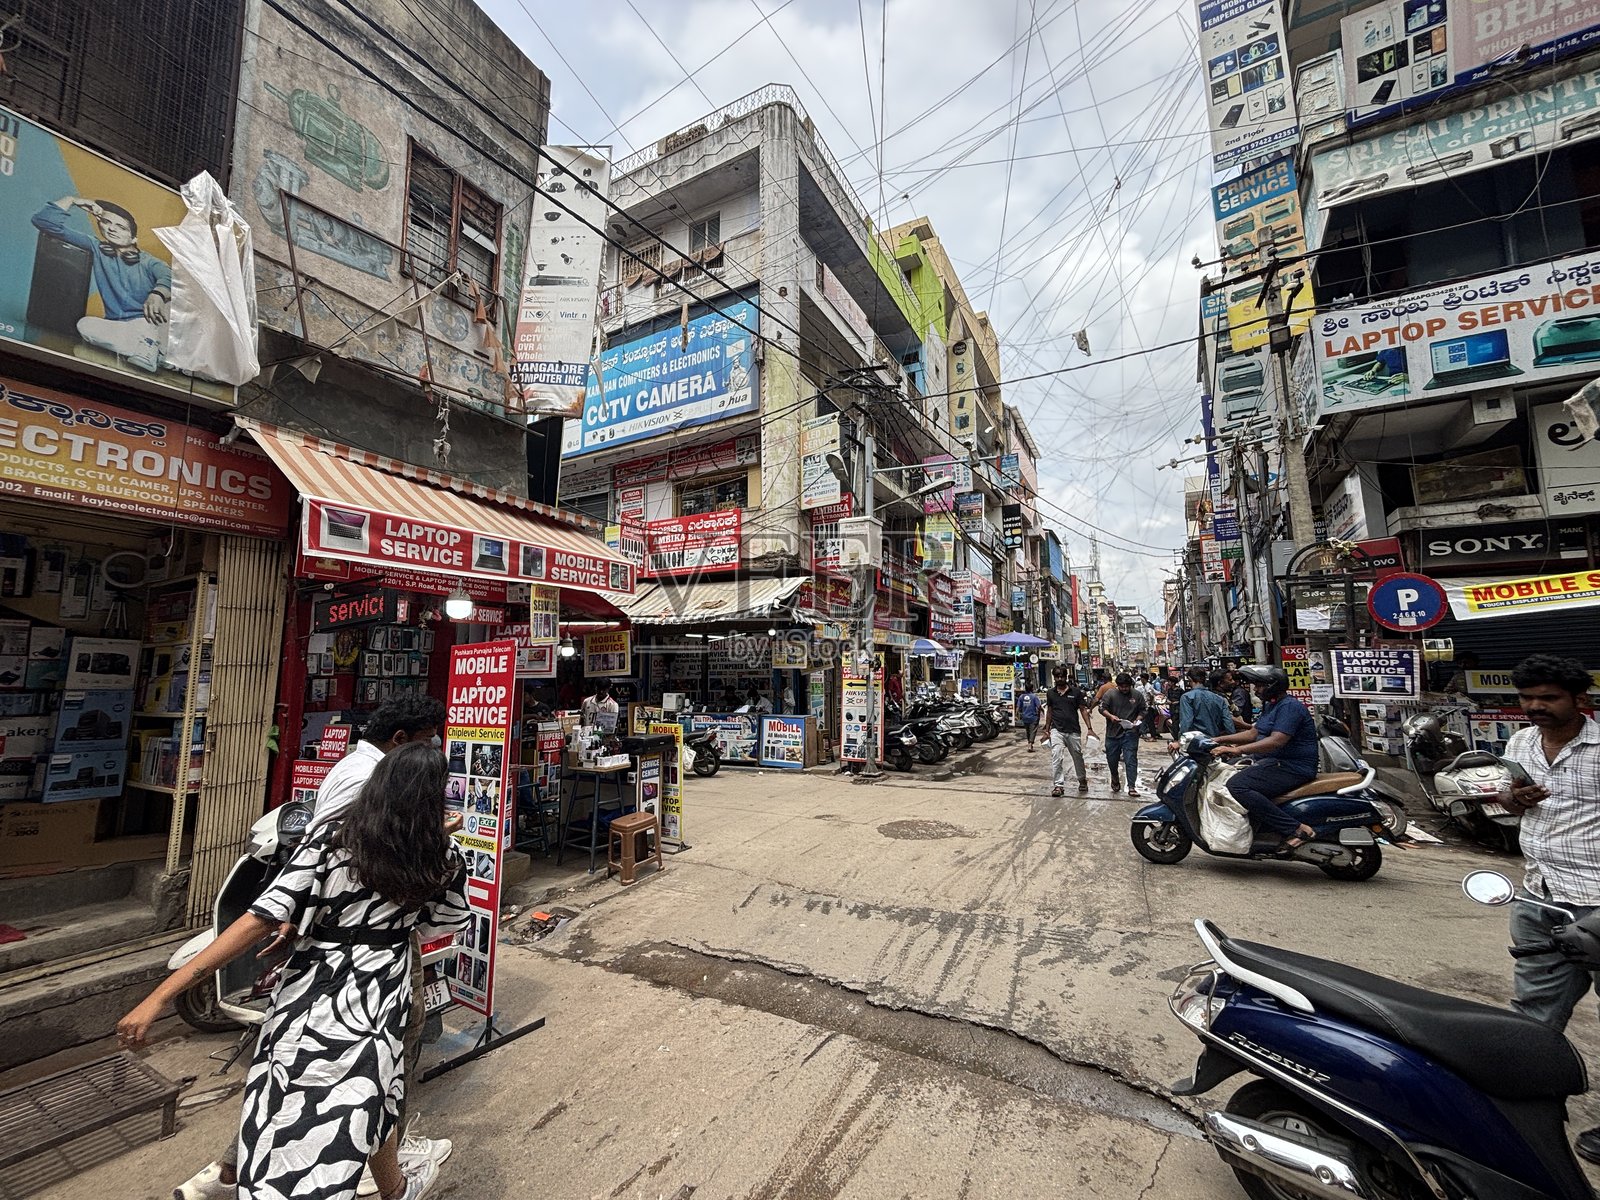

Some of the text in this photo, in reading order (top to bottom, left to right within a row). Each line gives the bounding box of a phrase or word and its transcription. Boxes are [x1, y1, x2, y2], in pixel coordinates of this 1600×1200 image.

[1203, 5, 1245, 27] TEMPERED
[1478, 18, 1560, 56] WHOLESALE
[1472, 70, 1489, 80] 2nd
[1447, 133, 1471, 148] of
[1483, 101, 1586, 138] Printers
[1225, 128, 1265, 147] 2nd Floor
[1328, 141, 1382, 170] SRI
[1393, 118, 1450, 150] SAI
[1217, 152, 1235, 161] Mob:
[1217, 162, 1288, 200] PRINTER
[1219, 175, 1291, 212] SERVICE
[560, 311, 587, 319] Vintrn
[1322, 317, 1349, 337] ಶ್ರೀ
[1325, 318, 1447, 357] LAPTOP
[586, 379, 617, 398] KANHAN
[618, 364, 660, 389] COMPUTERS
[662, 362, 668, 375] &
[670, 345, 720, 373] ELECTRONICS
[565, 375, 584, 386] INC.
[586, 370, 717, 426] CCTV CAMERA
[718, 393, 748, 408] ahua
[186, 436, 205, 447] PH:
[3, 466, 244, 517] BRACKETS, BLUETOOTH SPEAKERS
[34, 487, 75, 501] Email:
[74, 468, 114, 482] CCTV
[118, 477, 174, 494] CAMER,
[179, 488, 206, 501] UPS,
[210, 494, 269, 513] INVERTER,
[812, 504, 849, 515] AMBIKA
[385, 519, 462, 547] LAPTOP
[653, 533, 686, 545] AMBIKA
[1428, 533, 1543, 556] SONY
[380, 538, 464, 567] SERVICE
[554, 551, 605, 572] MOBILE
[354, 566, 383, 576] MOBILE
[385, 571, 414, 581] SERVICE
[421, 576, 447, 585] LAPTOP
[448, 580, 473, 589] SERICE
[551, 563, 607, 588] SERVICE
[405, 580, 417, 588] S.P.
[418, 582, 437, 591] Road,
[1472, 576, 1579, 602] MOBILE
[1397, 588, 1419, 611] P
[1540, 594, 1566, 602] FITTING
[478, 608, 503, 624] SERVICE
[496, 624, 531, 636] LAPT
[590, 634, 623, 645] MOBILE
[589, 643, 625, 653] SERVICE
[455, 655, 508, 675] MOBILE
[476, 676, 482, 686] &
[1480, 674, 1510, 685] MOB
[452, 686, 506, 704] LAPTOP
[448, 706, 507, 724] SERVICE
[324, 728, 347, 739] LAPTOP
[447, 727, 505, 739] Chiplevel Service
[652, 726, 678, 734] MOBILE
[769, 721, 801, 733] MOBILE
[539, 732, 564, 740] TEMPERED
[320, 741, 346, 751] SERVICE
[295, 765, 333, 774] MOBILE SERVIC
[641, 759, 659, 769] SERVICE
[294, 777, 313, 785] LAPTOP
[464, 836, 495, 851] ACCESSORIES
